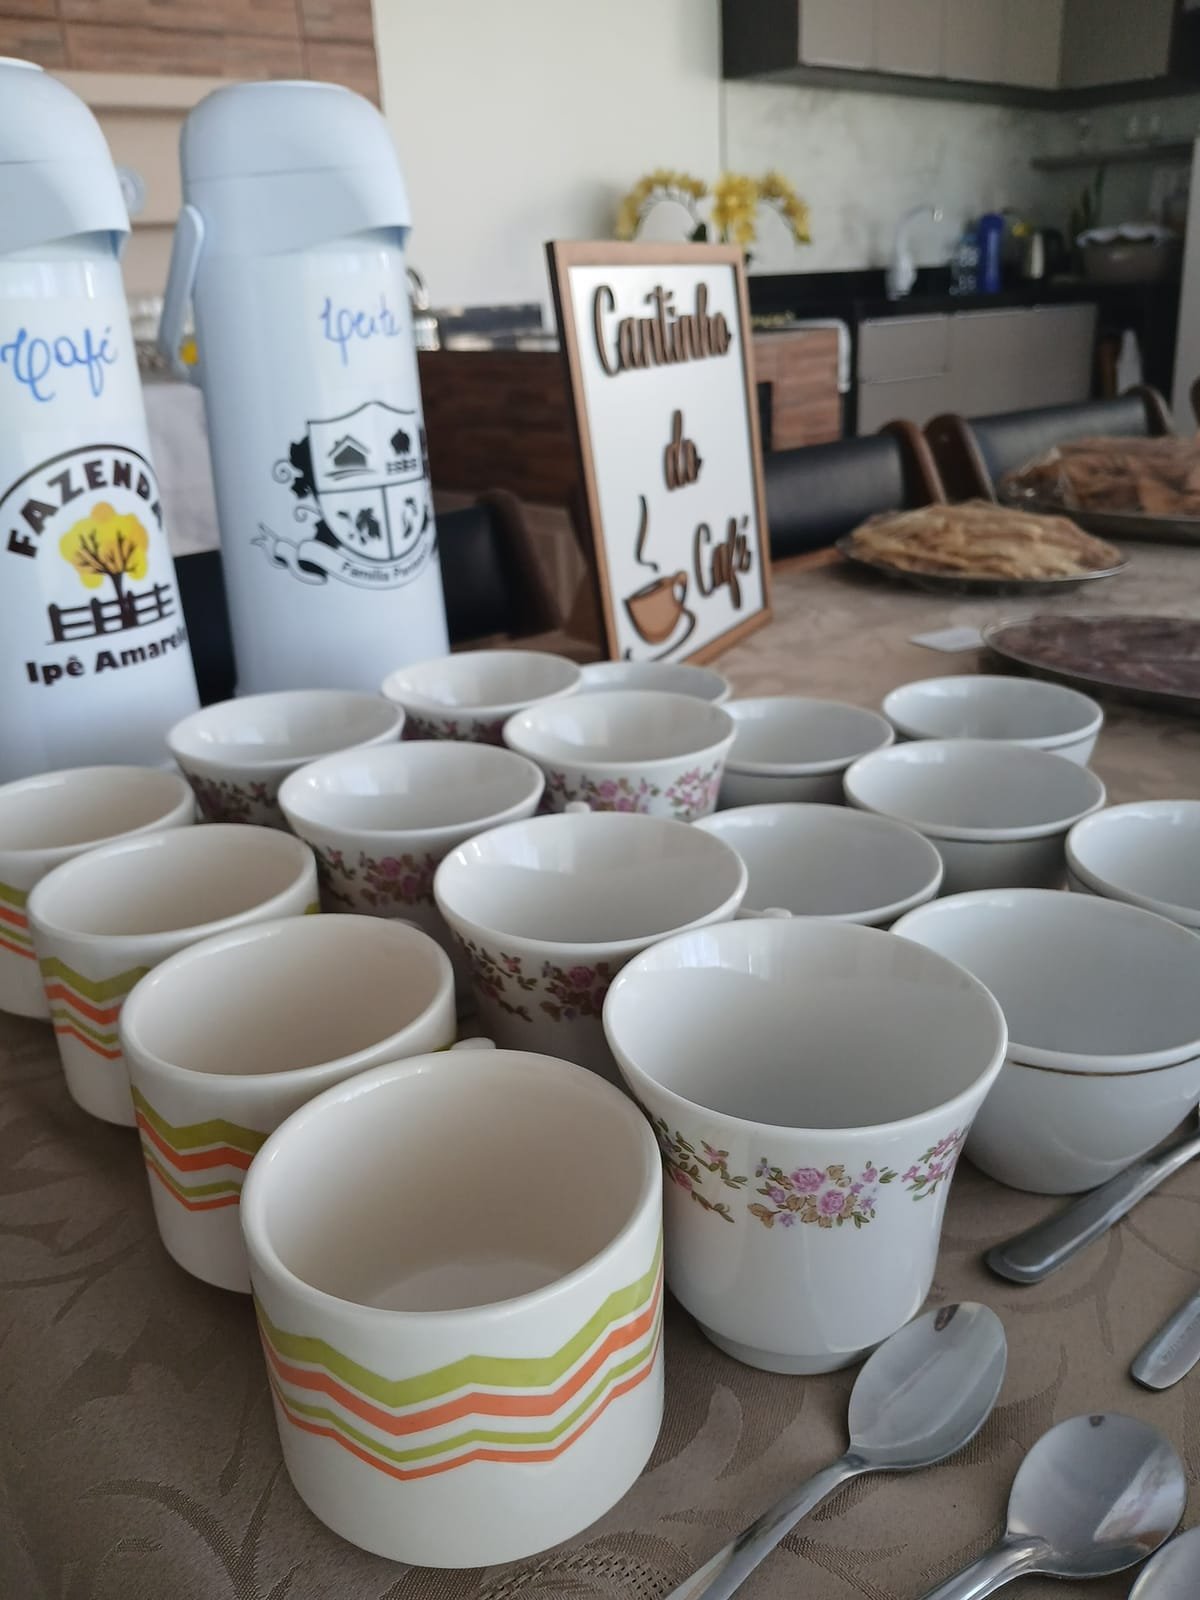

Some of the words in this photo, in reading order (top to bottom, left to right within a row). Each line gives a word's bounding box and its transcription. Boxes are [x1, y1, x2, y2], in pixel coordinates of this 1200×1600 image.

[594, 282, 731, 376] Cantinho
[664, 410, 702, 491] do
[694, 515, 751, 610] Café
[26, 656, 85, 686] Ipê
